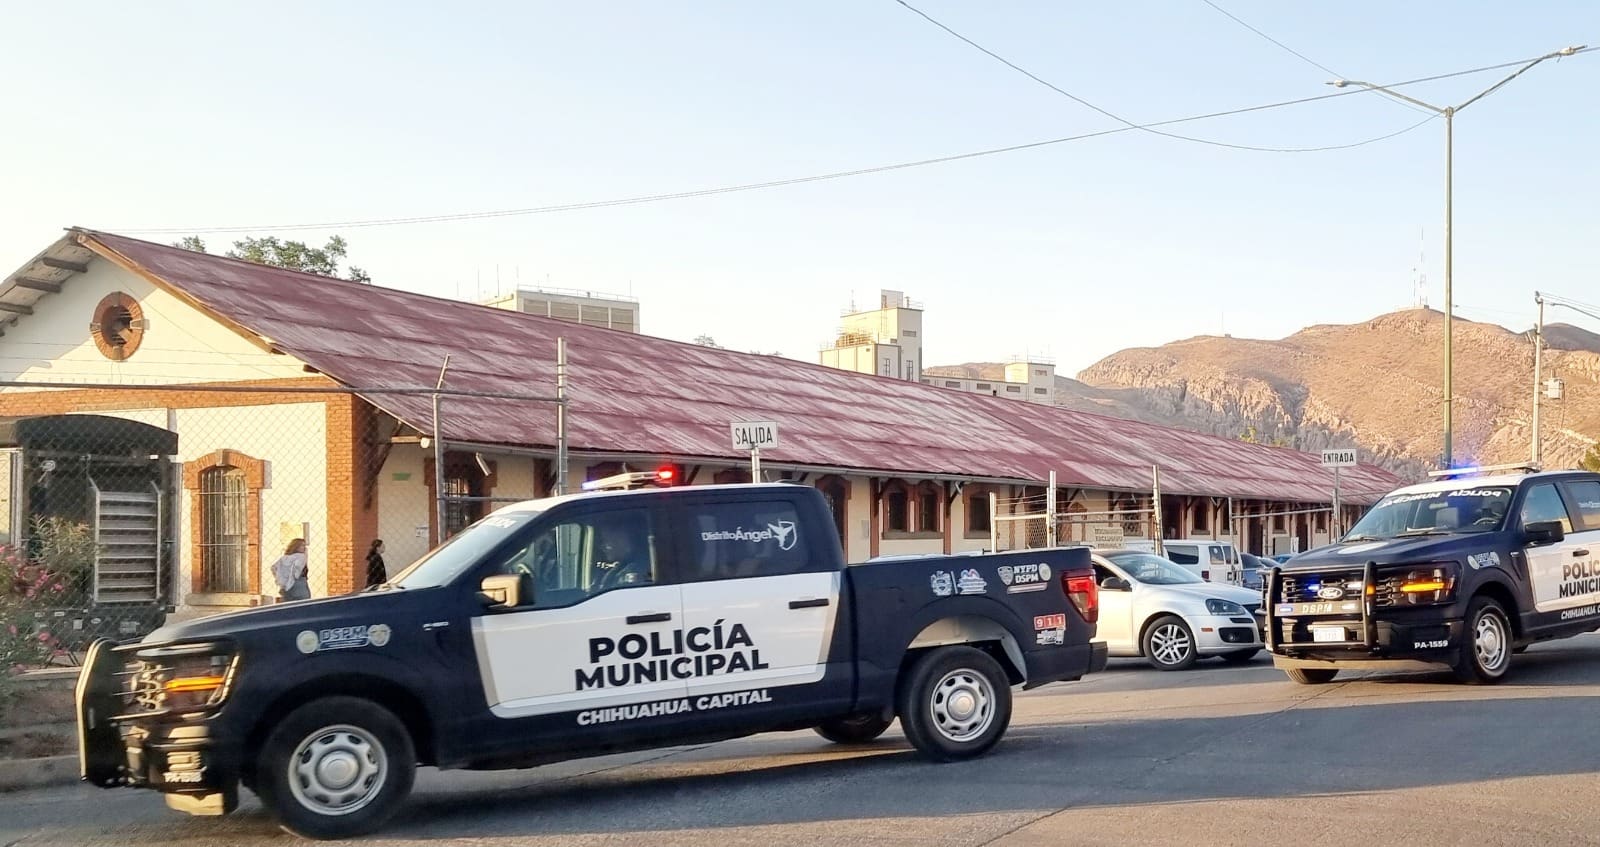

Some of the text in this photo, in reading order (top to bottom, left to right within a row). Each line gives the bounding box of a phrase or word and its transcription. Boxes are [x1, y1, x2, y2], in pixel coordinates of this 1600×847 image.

[735, 427, 773, 445] SALIDA
[1323, 452, 1354, 464] ENTRADA
[1013, 564, 1038, 574] NYPD
[1015, 572, 1039, 584] DSPM
[1302, 603, 1333, 613] DSPM
[1561, 605, 1596, 620] CHIHUAHUA
[1036, 616, 1062, 628] 911
[320, 625, 368, 641] DSPM
[589, 619, 754, 664] POLICÍA
[575, 649, 770, 691] MUNICIPAL
[577, 689, 773, 726] CHIHUAHUA CAPITAL
